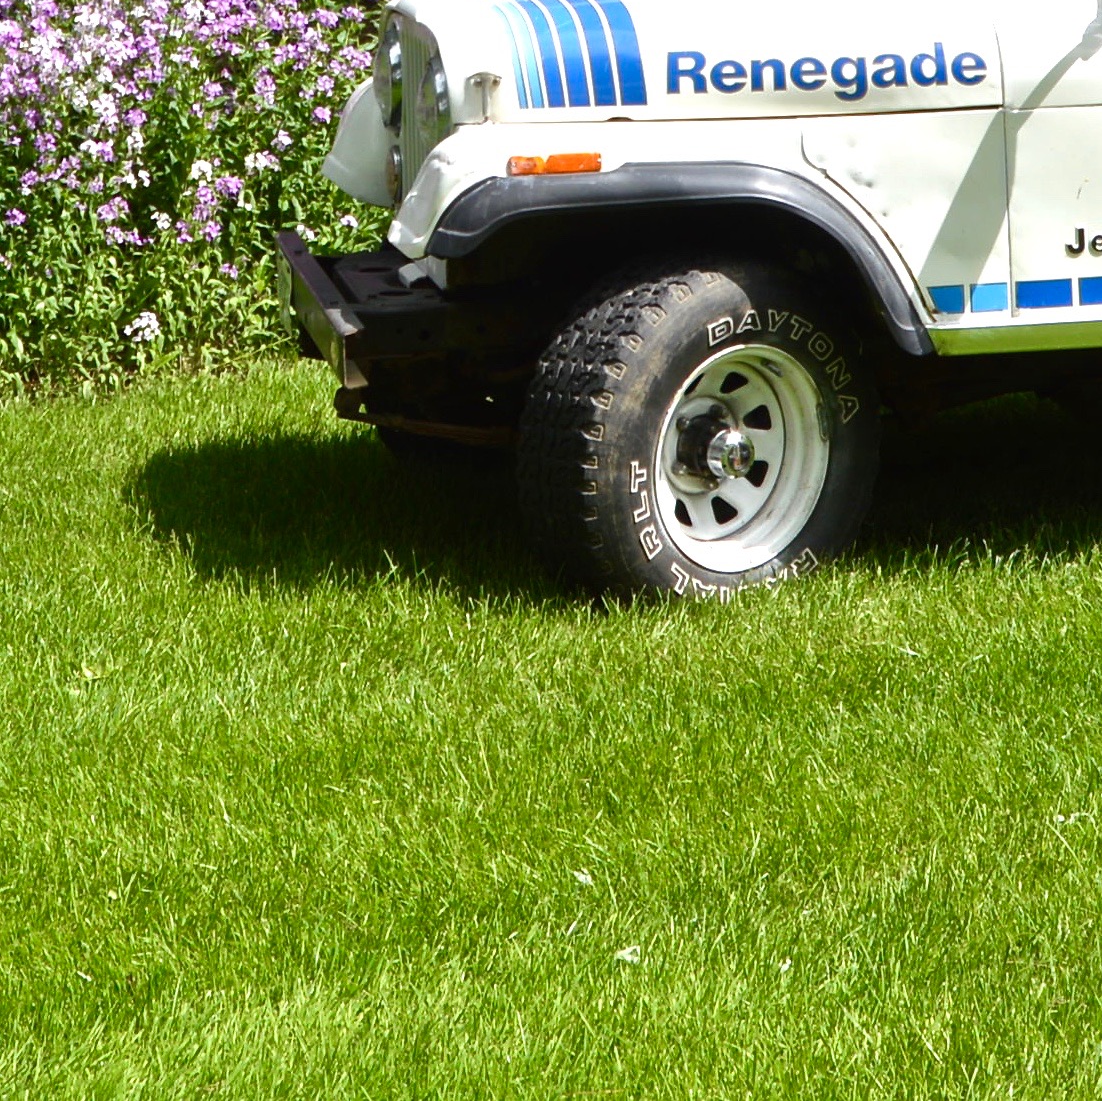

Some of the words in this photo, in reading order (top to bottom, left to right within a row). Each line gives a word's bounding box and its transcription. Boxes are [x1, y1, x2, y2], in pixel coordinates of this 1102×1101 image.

[666, 42, 988, 102] Renegade
[707, 309, 859, 424] DAYTONA
[630, 461, 662, 560] RLT
